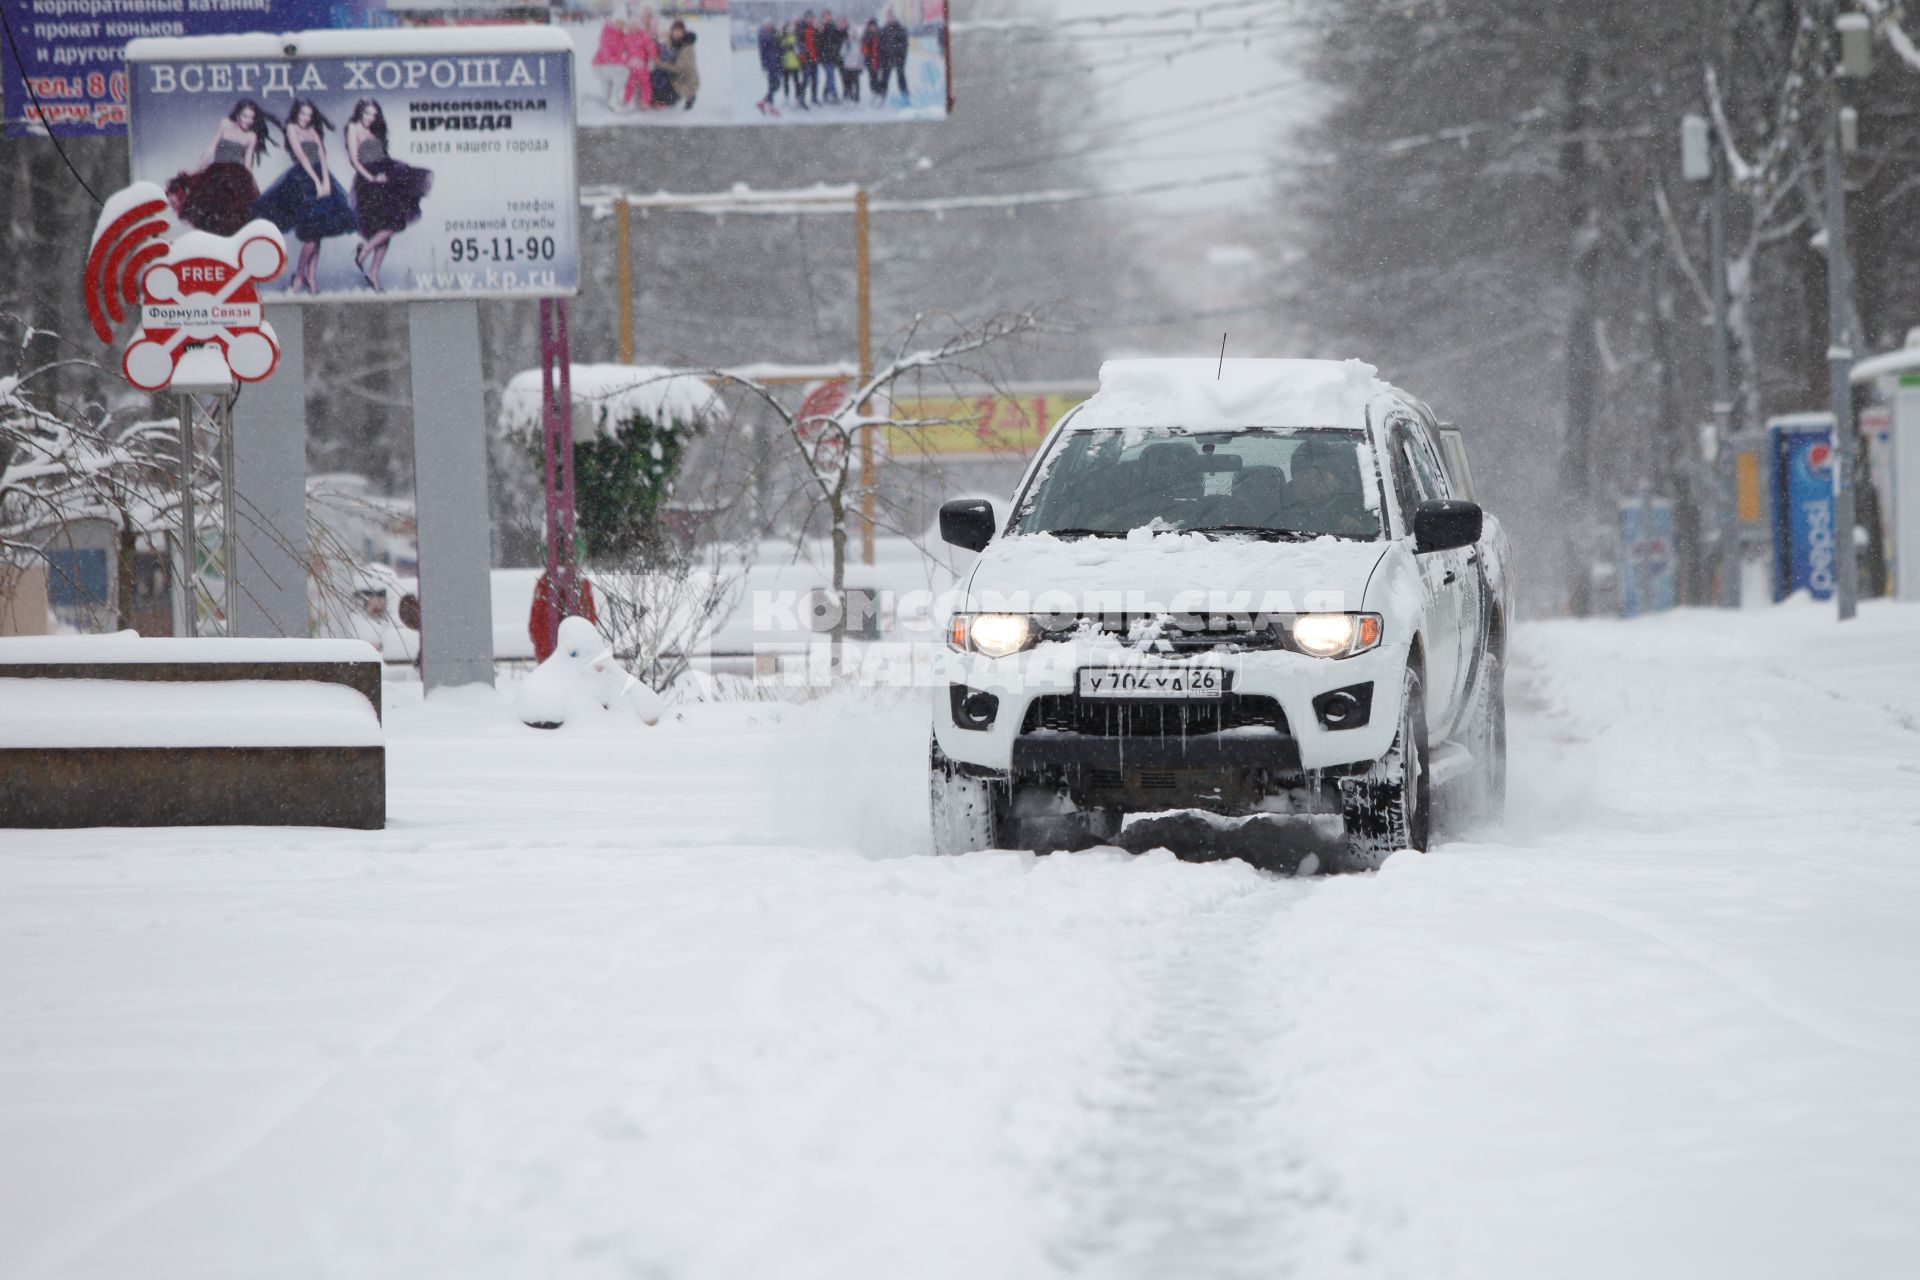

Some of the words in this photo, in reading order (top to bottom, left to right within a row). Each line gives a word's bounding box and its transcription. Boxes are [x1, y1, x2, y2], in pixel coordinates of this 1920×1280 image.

[33, 0, 183, 17] корпоративные
[34, 22, 99, 41] прокат
[106, 20, 184, 37] коньков
[36, 47, 48, 61] и
[150, 63, 327, 98] ВСЕГДА
[343, 57, 547, 91] ХОРОША!
[410, 114, 512, 132] ПРАВДА
[410, 141, 451, 154] газета
[455, 139, 502, 153] нашего
[506, 138, 549, 152] города
[507, 200, 554, 213] телефон
[445, 217, 506, 232] рекламной
[511, 216, 555, 231] службы
[450, 236, 556, 262] 95-11-90
[181, 266, 225, 282] FREE
[415, 267, 557, 291] www.kp.ru
[149, 307, 208, 321] Формула
[211, 306, 251, 318] Связи
[1191, 671, 1215, 689] 26
